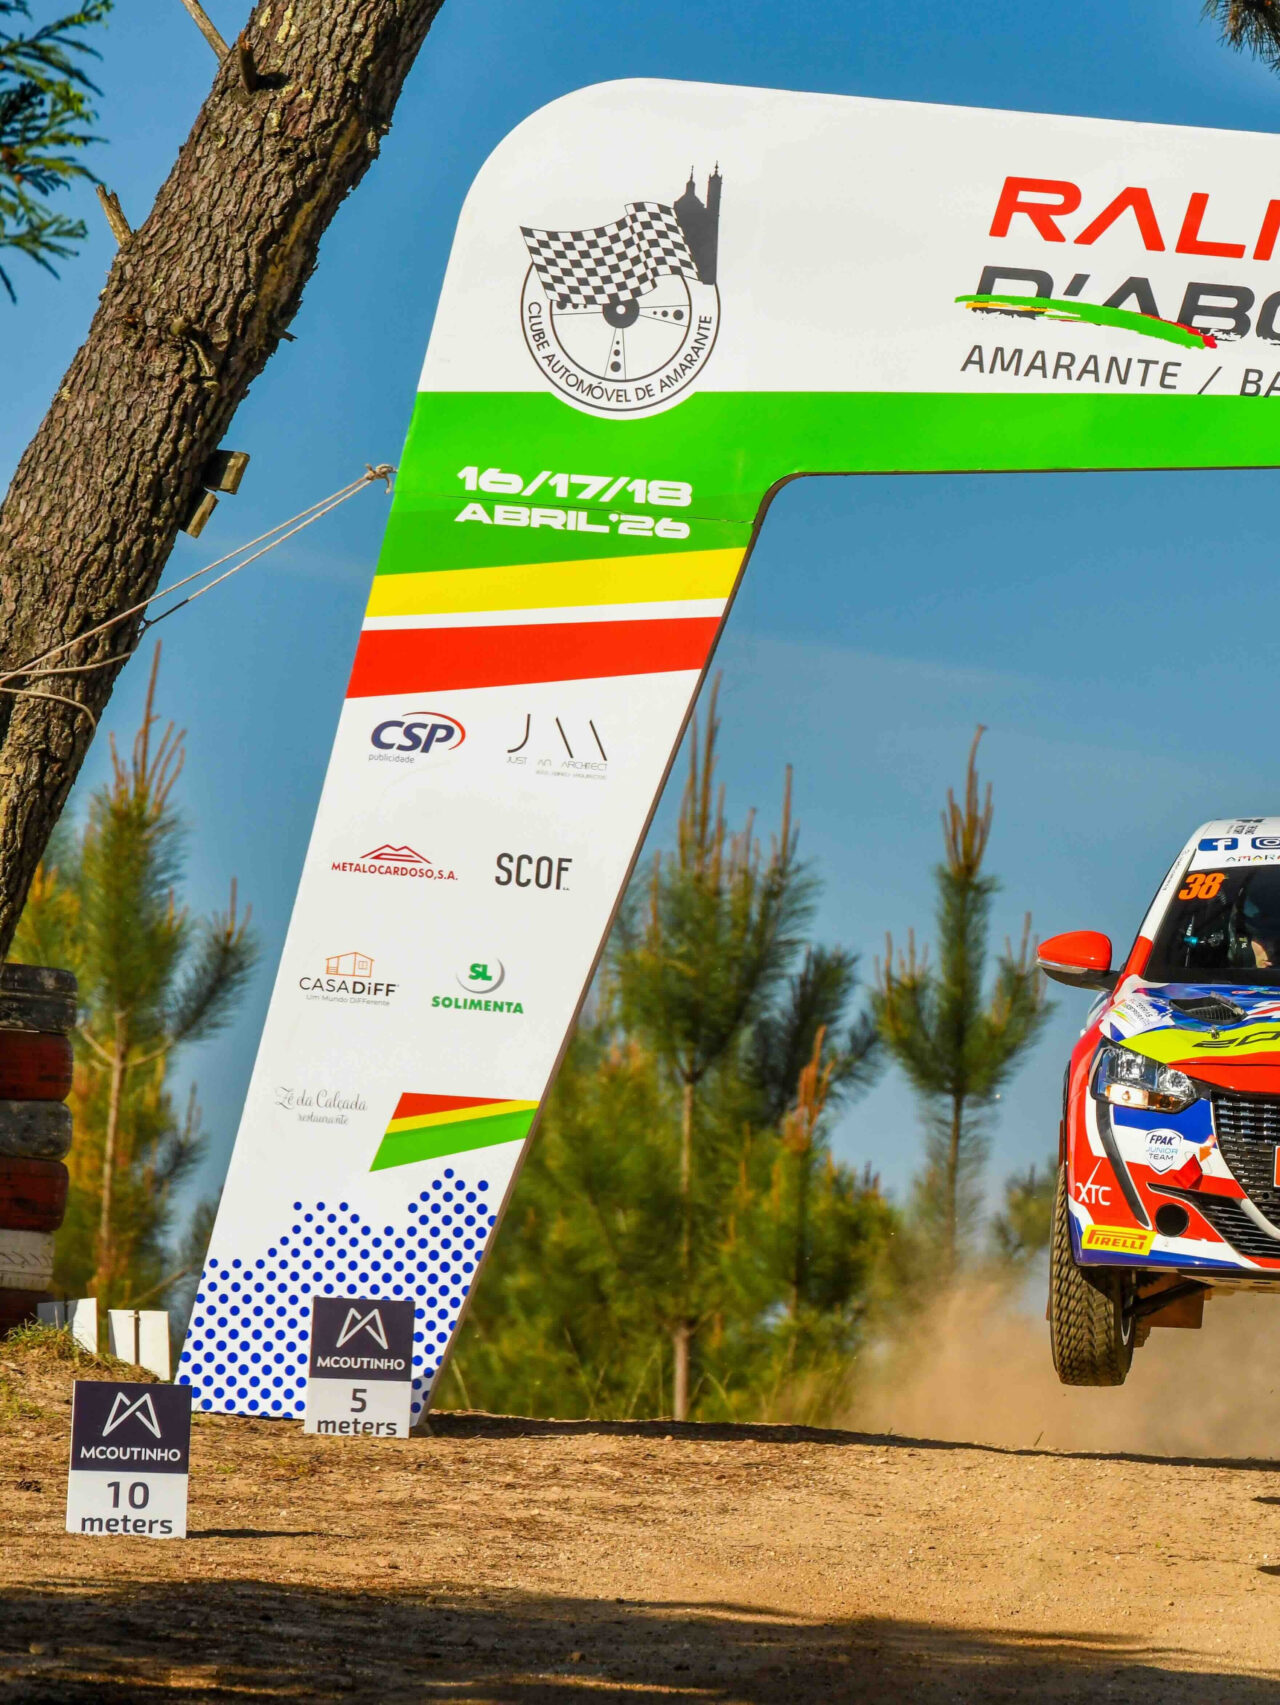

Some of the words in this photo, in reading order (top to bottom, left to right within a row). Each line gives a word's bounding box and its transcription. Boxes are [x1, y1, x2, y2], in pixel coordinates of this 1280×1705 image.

[527, 301, 551, 352] CLUBE
[541, 354, 632, 403] AUTOMÓVEL
[635, 382, 656, 399] DE
[658, 315, 713, 393] AMARANTE
[961, 344, 1182, 390] AMARANTE
[456, 465, 693, 507] 16/17/18
[371, 720, 455, 754] CSP
[368, 753, 415, 764] publicidade
[495, 852, 573, 891] SCOF
[1178, 872, 1226, 900] 38
[468, 963, 493, 981] SL
[431, 995, 525, 1014] SOLIMENTA
[296, 1089, 313, 1106] da
[316, 1088, 367, 1112] Calçada
[1145, 1146, 1179, 1155] JUNIOR
[1149, 1134, 1177, 1146] FPAK
[1149, 1153, 1174, 1161] TEAM
[1086, 1229, 1148, 1251] PIRELLI
[316, 1355, 406, 1371] MCOUTINHO
[350, 1388, 368, 1413] 5
[316, 1418, 398, 1437] meters
[80, 1446, 181, 1462] MCOUTINHO
[106, 1481, 150, 1510] 10
[80, 1514, 173, 1535] meters
